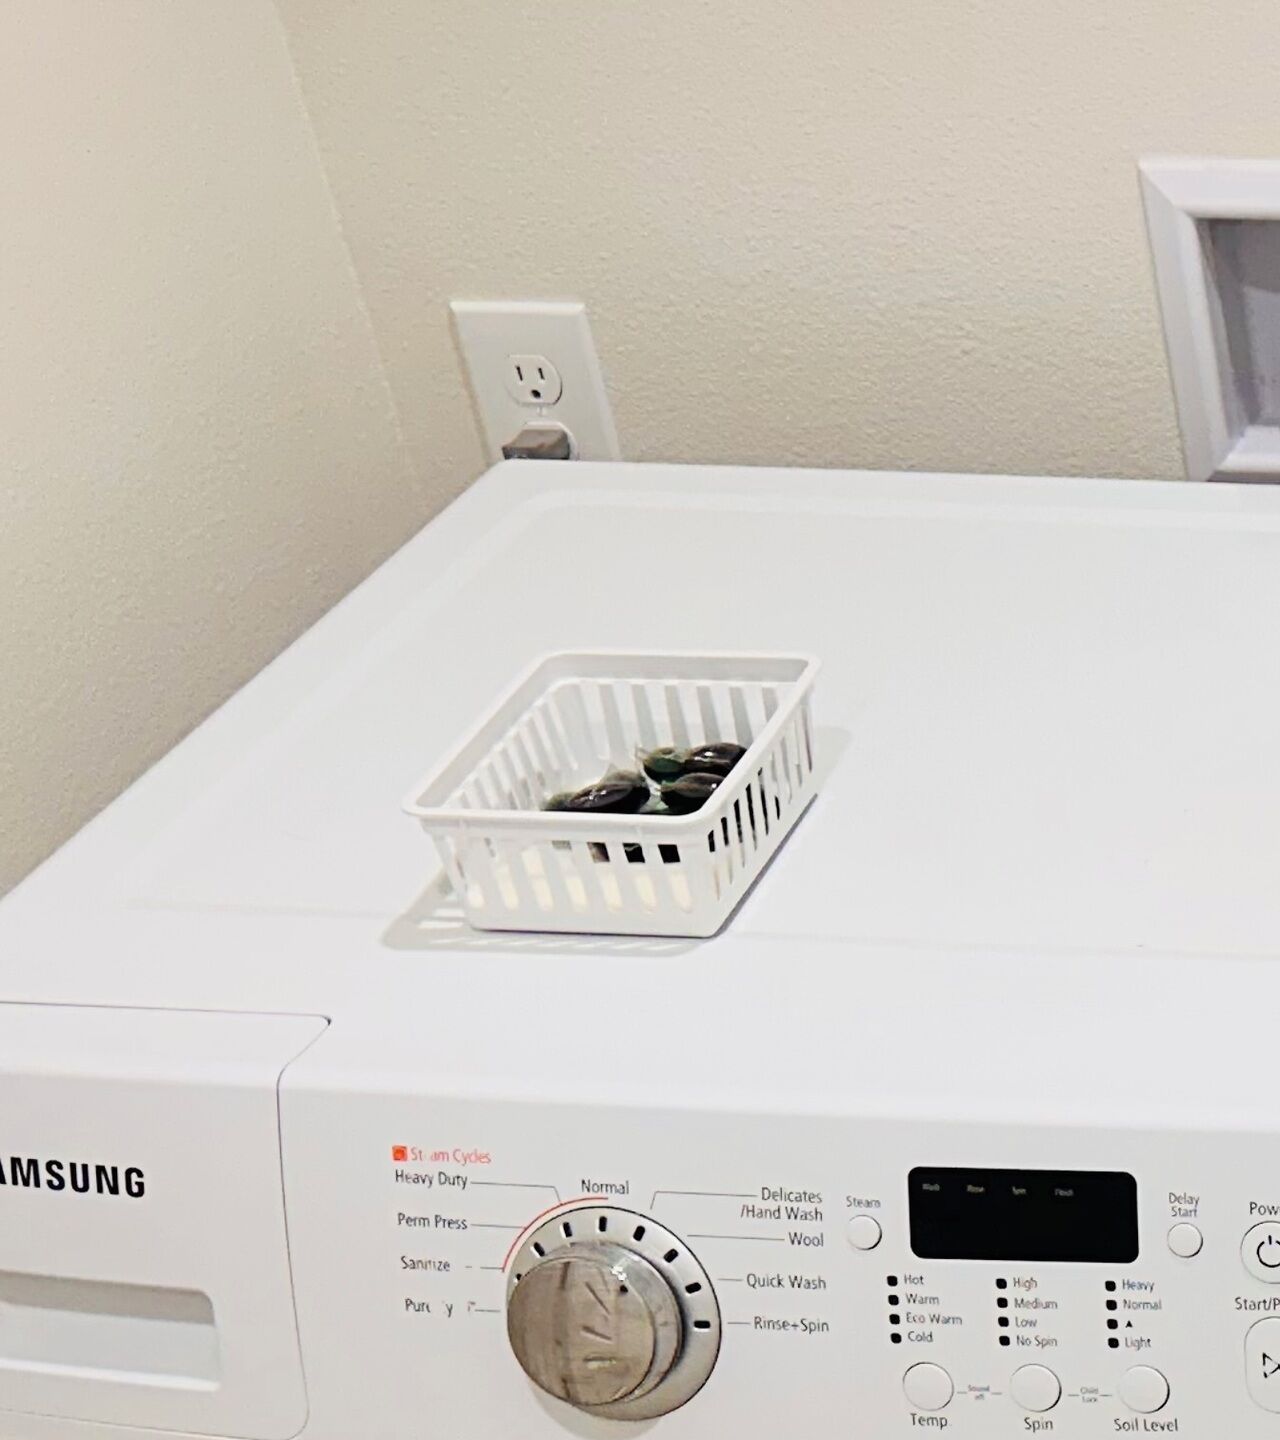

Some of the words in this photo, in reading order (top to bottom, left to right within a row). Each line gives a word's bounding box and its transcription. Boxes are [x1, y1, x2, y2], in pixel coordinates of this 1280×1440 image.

[411, 1147, 449, 1161] Stam
[453, 1149, 491, 1166] Cycles
[395, 1169, 434, 1188] Heavy
[438, 1171, 467, 1190] Duty
[581, 1179, 629, 1194] Normal
[762, 1187, 822, 1204] Delicates
[846, 1196, 881, 1208] Steam
[1169, 1192, 1199, 1206] Delay
[741, 1205, 781, 1219] /Hand
[785, 1206, 822, 1221] Wash
[1171, 1205, 1197, 1217] Start
[397, 1212, 430, 1227] Perm
[434, 1214, 468, 1230] Press
[788, 1232, 824, 1247] Wool
[747, 1273, 785, 1289] Quick
[788, 1275, 826, 1290] Wash
[904, 1274, 924, 1285] Hot
[1013, 1277, 1037, 1291] High
[1122, 1279, 1154, 1293] Heavy
[905, 1293, 939, 1304] Warm
[1014, 1298, 1058, 1309] Medium
[1123, 1299, 1162, 1310] Normal
[754, 1316, 829, 1334] Rinse+Spin
[906, 1312, 925, 1323] Eco
[928, 1314, 962, 1325] Warm
[1015, 1317, 1037, 1327] Low
[908, 1331, 933, 1342] Cold
[1017, 1335, 1032, 1346] No
[1034, 1335, 1057, 1348] Spin
[1125, 1337, 1151, 1351] Light
[1024, 1417, 1053, 1433] Spin
[1114, 1418, 1139, 1431] Soil
[1143, 1418, 1178, 1432] Level
